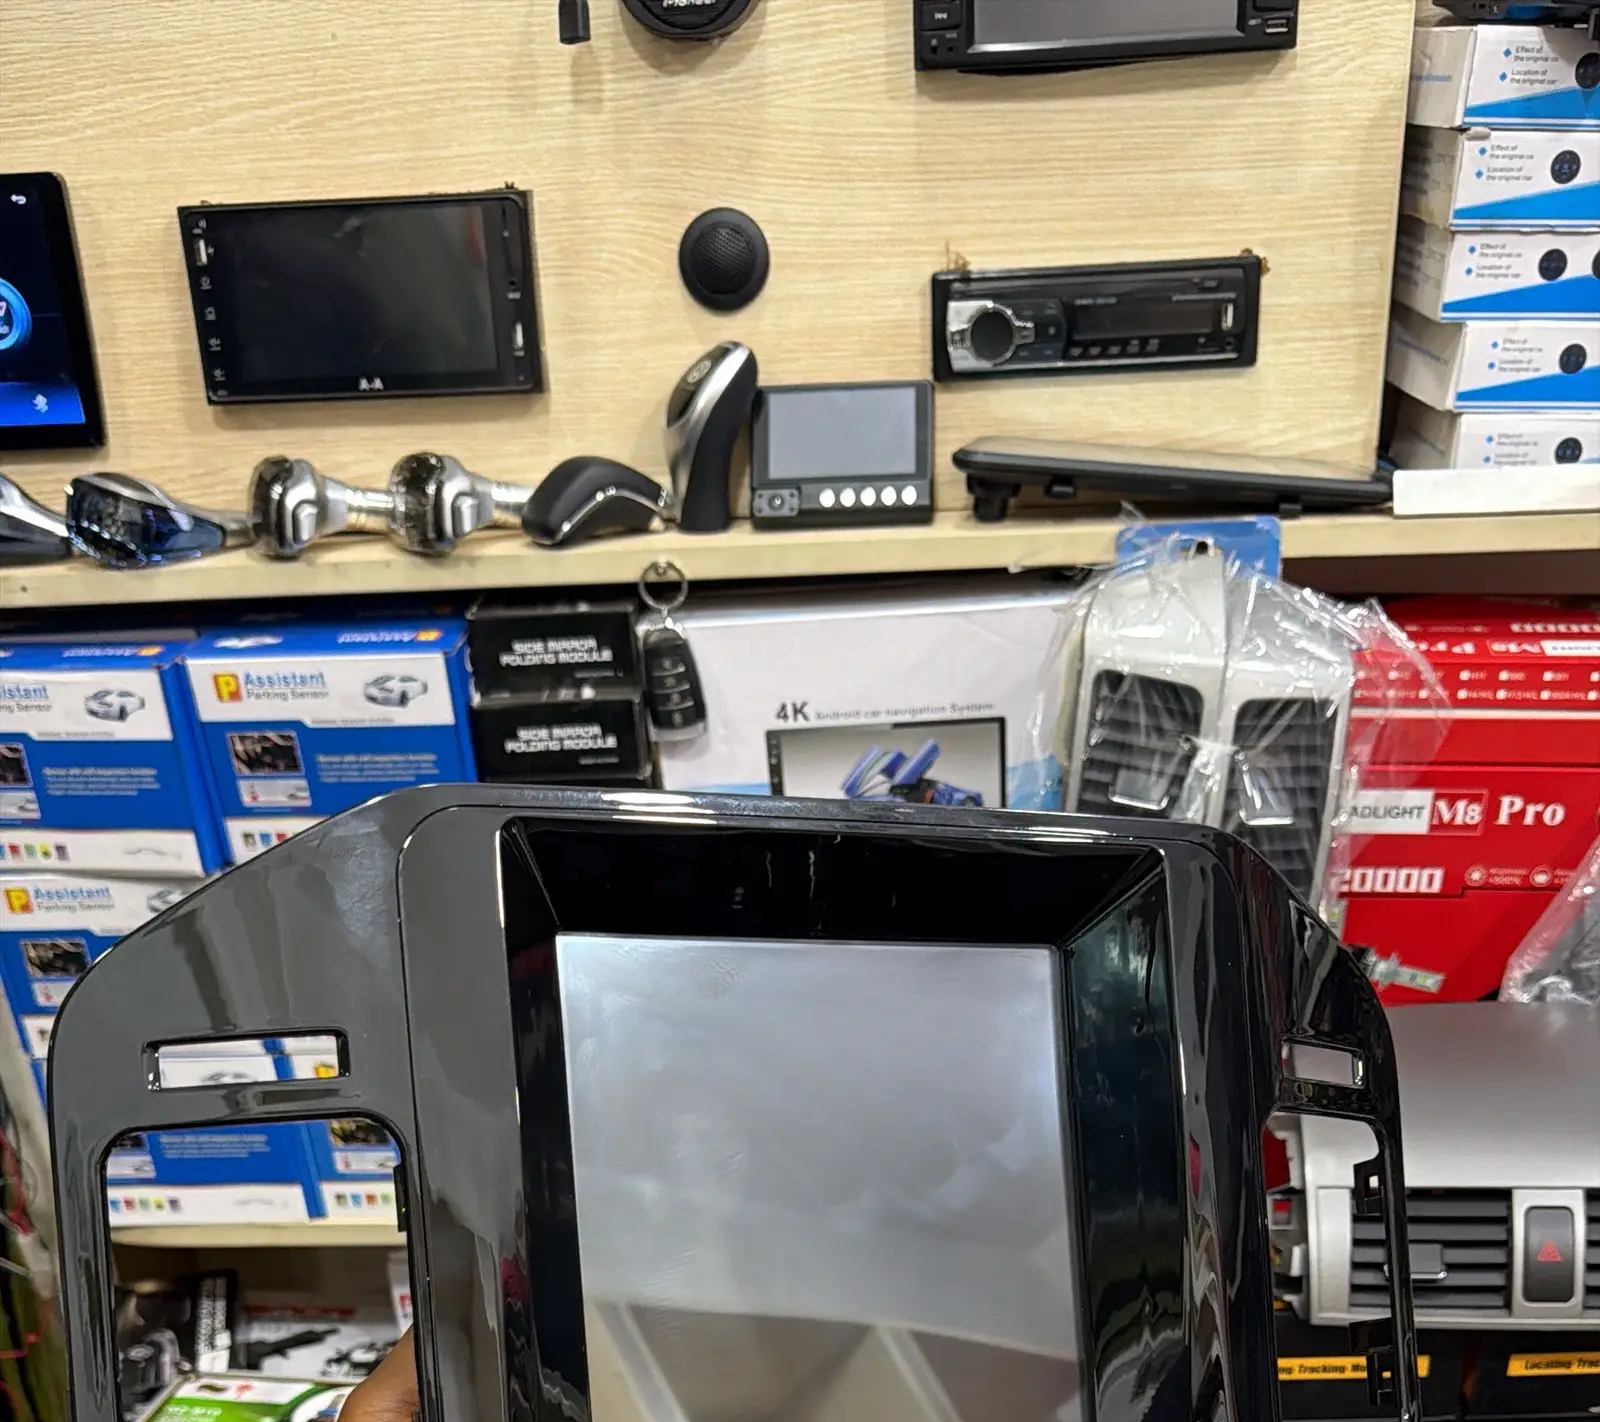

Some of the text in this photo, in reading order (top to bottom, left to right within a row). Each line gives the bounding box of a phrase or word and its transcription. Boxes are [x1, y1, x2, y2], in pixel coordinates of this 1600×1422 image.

[512, 636, 598, 653] SIDE MIRROR
[500, 646, 613, 666] FOLDING MODULE
[244, 671, 325, 688] Assistant
[248, 689, 328, 702] Parking Sensor
[776, 701, 809, 722] 4K
[517, 723, 602, 741] SIDE MIRROR
[504, 733, 617, 753] FOLDING MODULE
[1432, 798, 1484, 826] M8
[1494, 795, 1566, 827] Pro
[34, 887, 111, 901] Assistant
